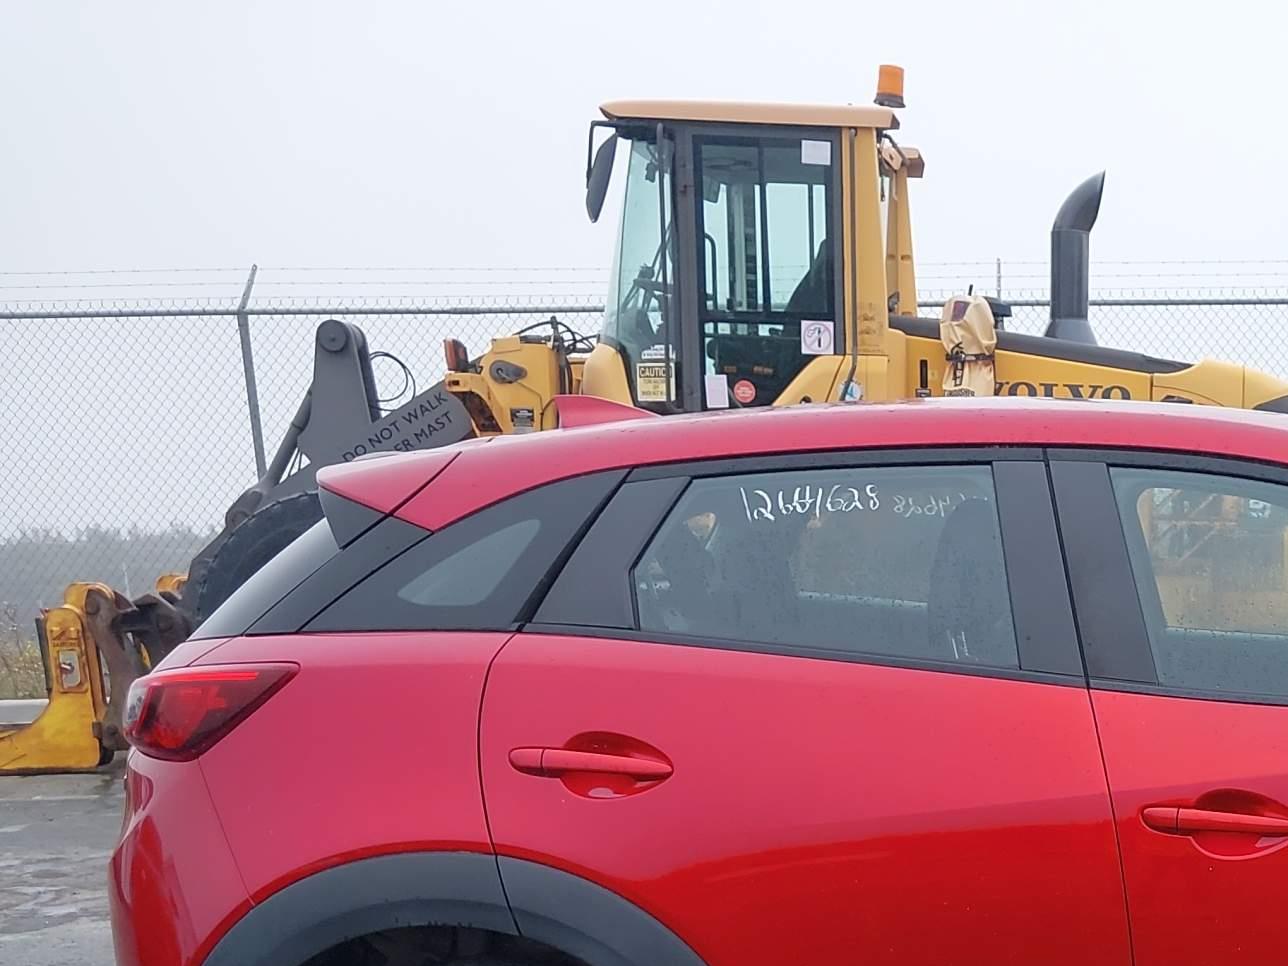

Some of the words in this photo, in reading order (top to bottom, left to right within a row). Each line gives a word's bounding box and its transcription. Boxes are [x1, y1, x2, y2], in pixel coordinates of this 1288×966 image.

[639, 367, 672, 378] CAUTIO
[342, 444, 368, 462] DO
[367, 420, 401, 449] NOT
[401, 391, 449, 425] WALK
[413, 410, 453, 443] MAST
